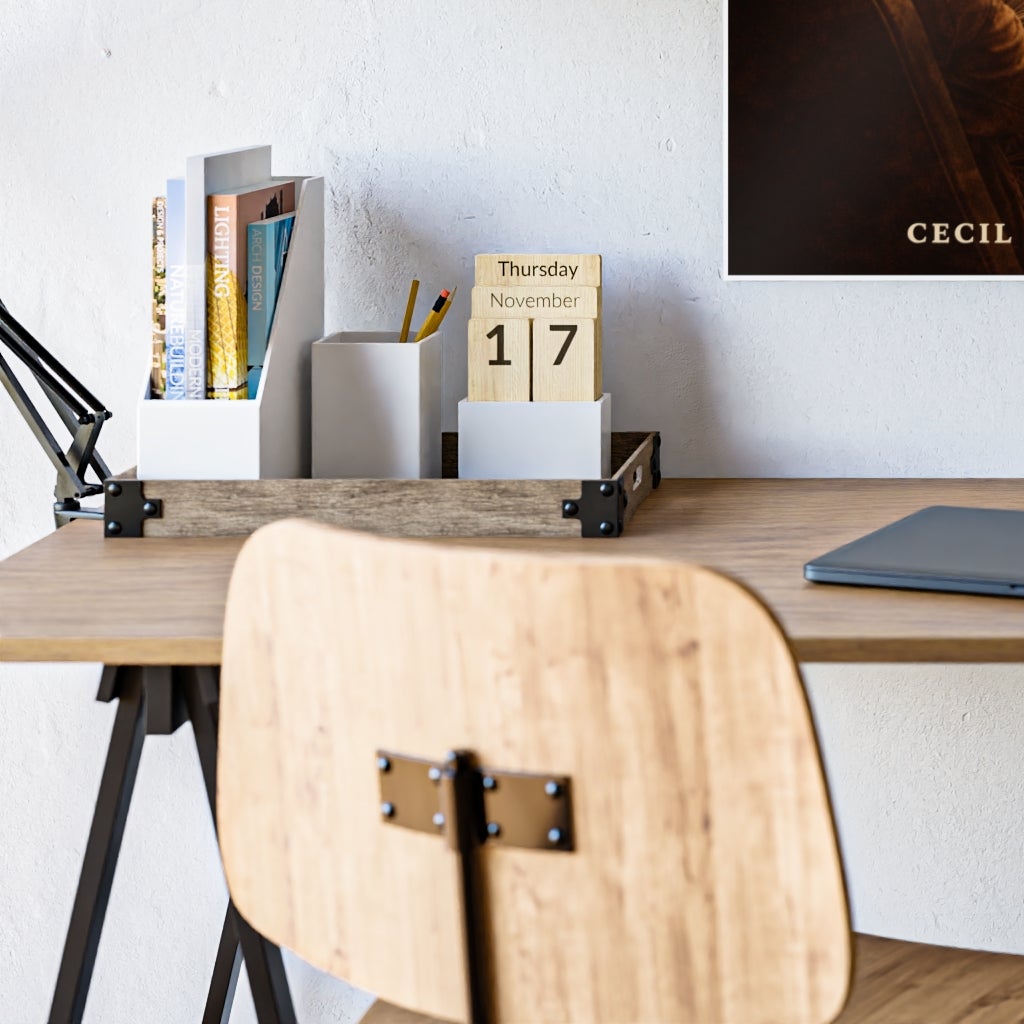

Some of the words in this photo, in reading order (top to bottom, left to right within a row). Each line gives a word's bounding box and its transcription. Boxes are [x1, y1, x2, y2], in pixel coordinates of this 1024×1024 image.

[251, 228, 263, 262] ARCH
[907, 222, 1013, 244] CECIL
[214, 206, 230, 298] LIGHTING
[498, 261, 579, 280] Thursday
[251, 265, 263, 311] DESIGN
[490, 292, 580, 308] November
[188, 329, 202, 399] MODERN
